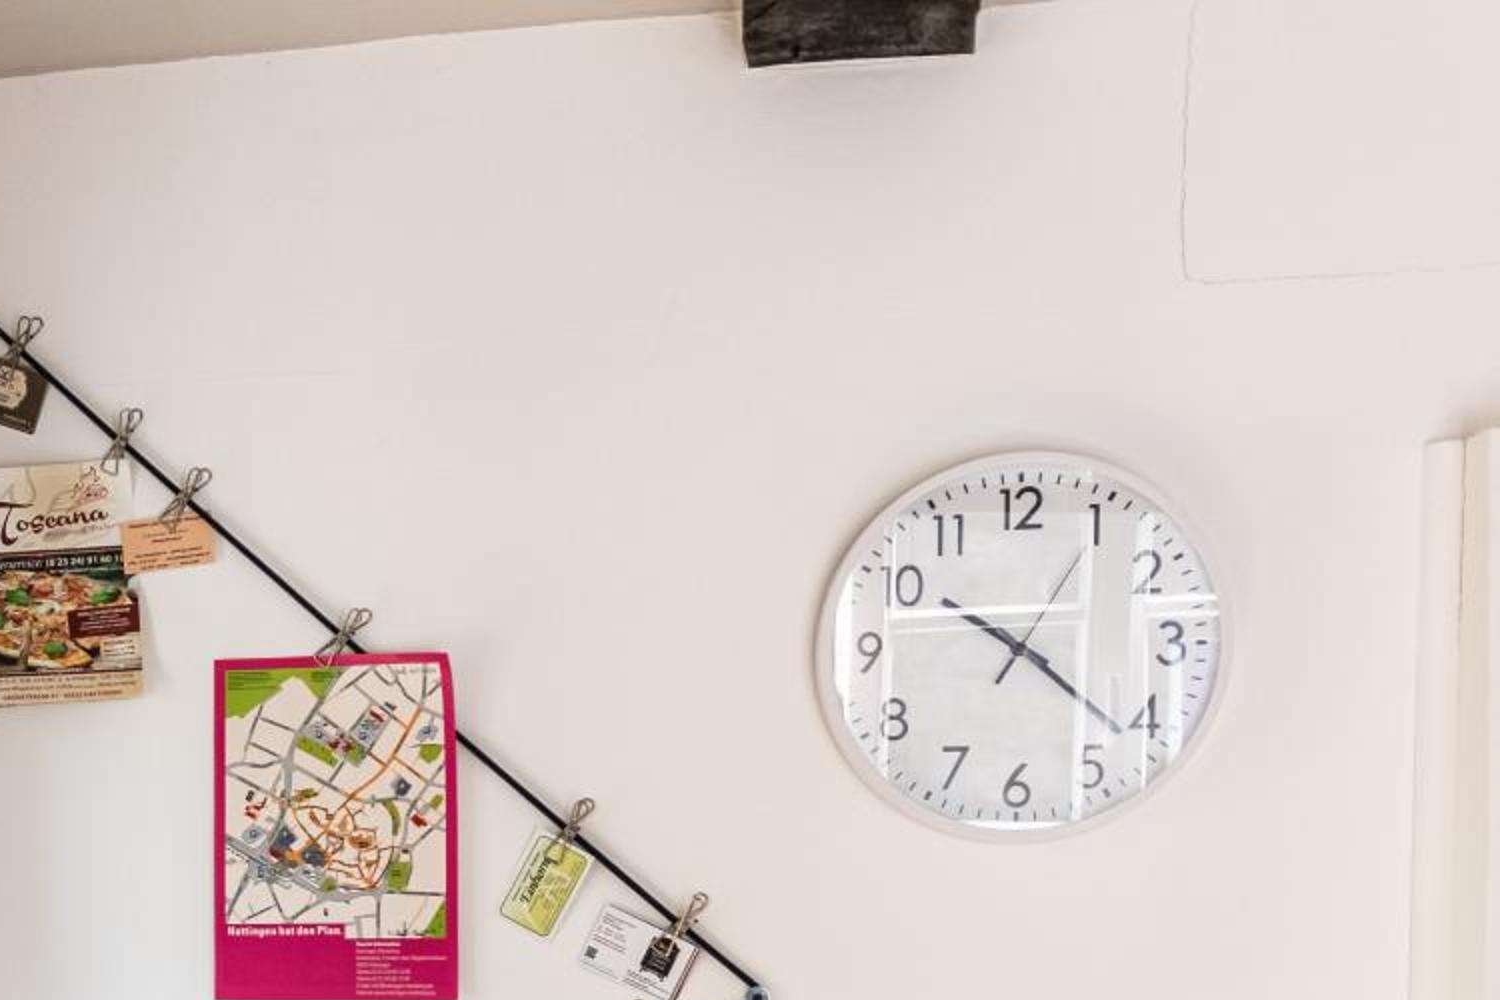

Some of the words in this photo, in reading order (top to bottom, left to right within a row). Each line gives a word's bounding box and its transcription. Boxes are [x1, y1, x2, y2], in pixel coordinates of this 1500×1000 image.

[1000, 486, 1044, 531] 12
[1088, 503, 1101, 547] 1
[933, 514, 963, 557] 11
[880, 564, 923, 607] 10
[1132, 549, 1163, 594] 2
[857, 632, 883, 673] 9
[1156, 620, 1186, 666] 3
[880, 698, 909, 741] 8
[1128, 693, 1161, 739] 4
[942, 745, 970, 790] 7
[1002, 763, 1031, 808] 6
[1082, 744, 1104, 789] 5
[227, 925, 277, 939] Hattingen
[278, 925, 295, 937] hat
